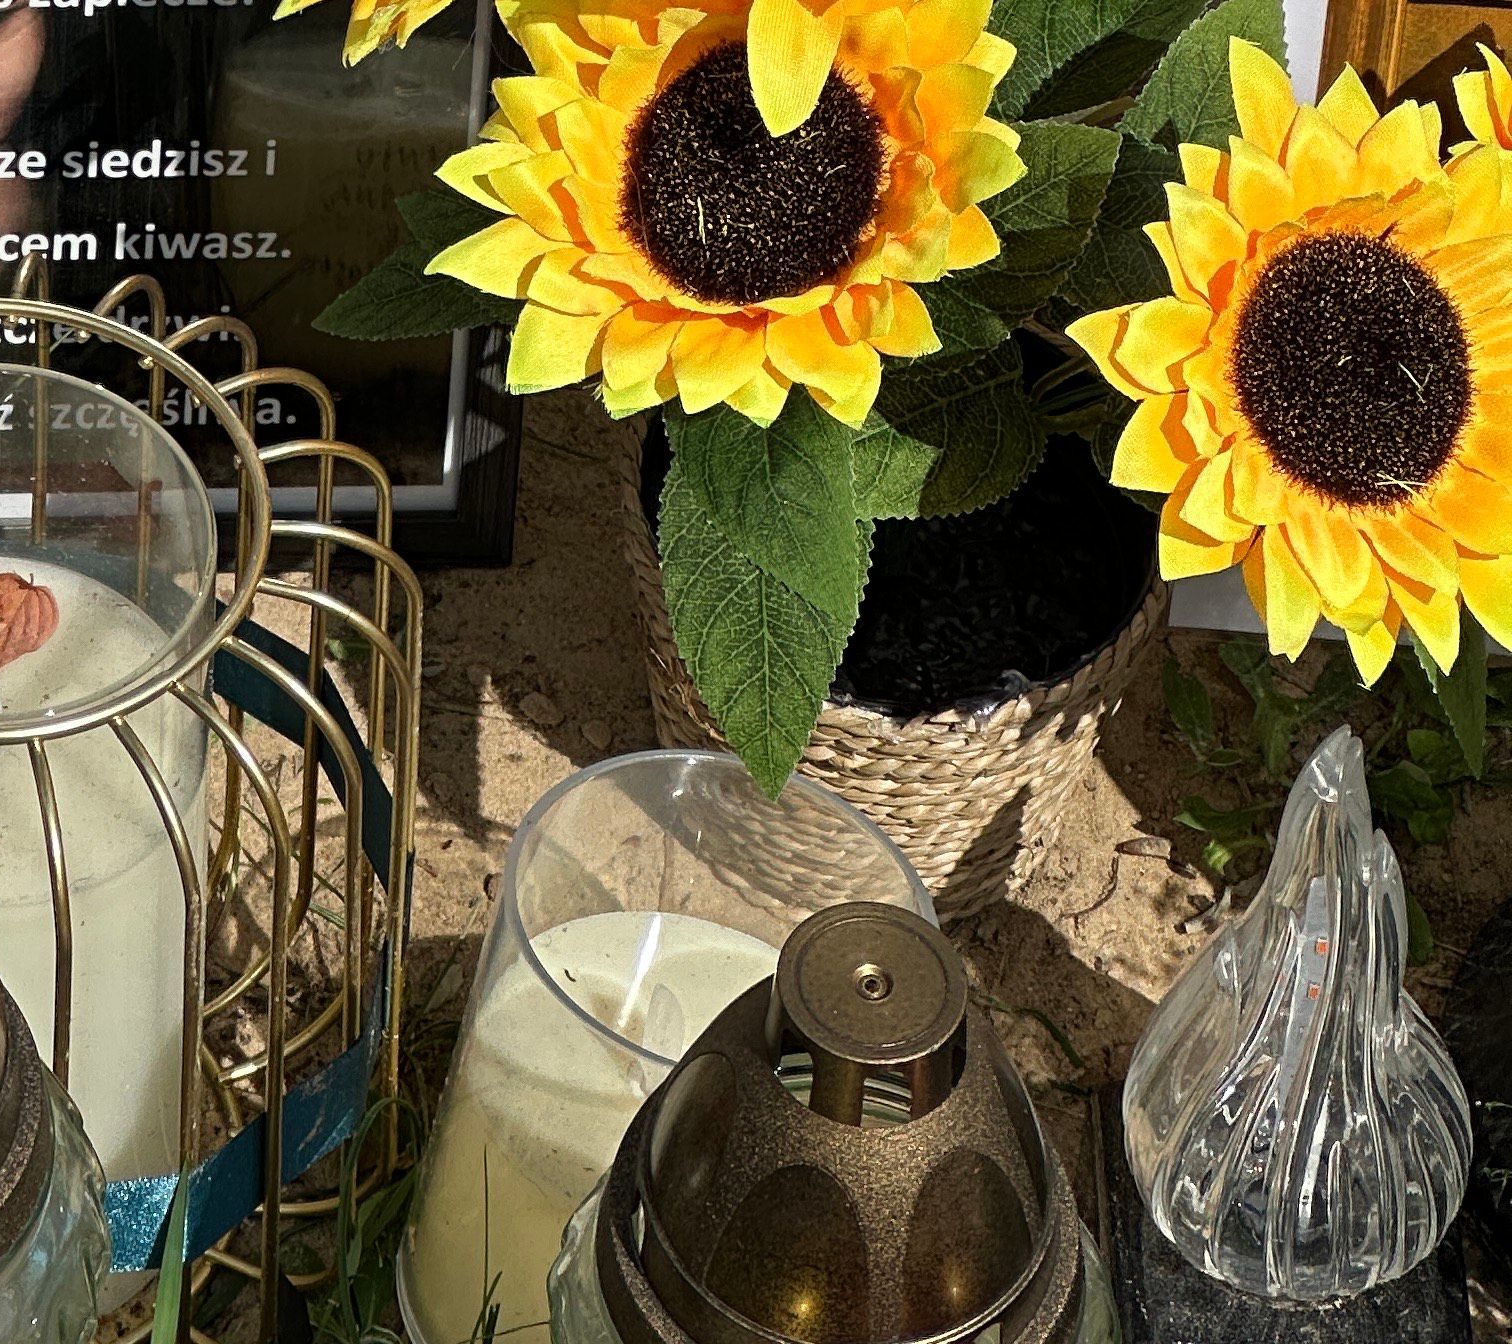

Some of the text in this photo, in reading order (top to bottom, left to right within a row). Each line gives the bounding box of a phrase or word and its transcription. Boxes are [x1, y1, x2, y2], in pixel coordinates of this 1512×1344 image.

[61, 138, 250, 180] siedzisz
[263, 138, 277, 179] i
[113, 221, 292, 262] kiwasz.
